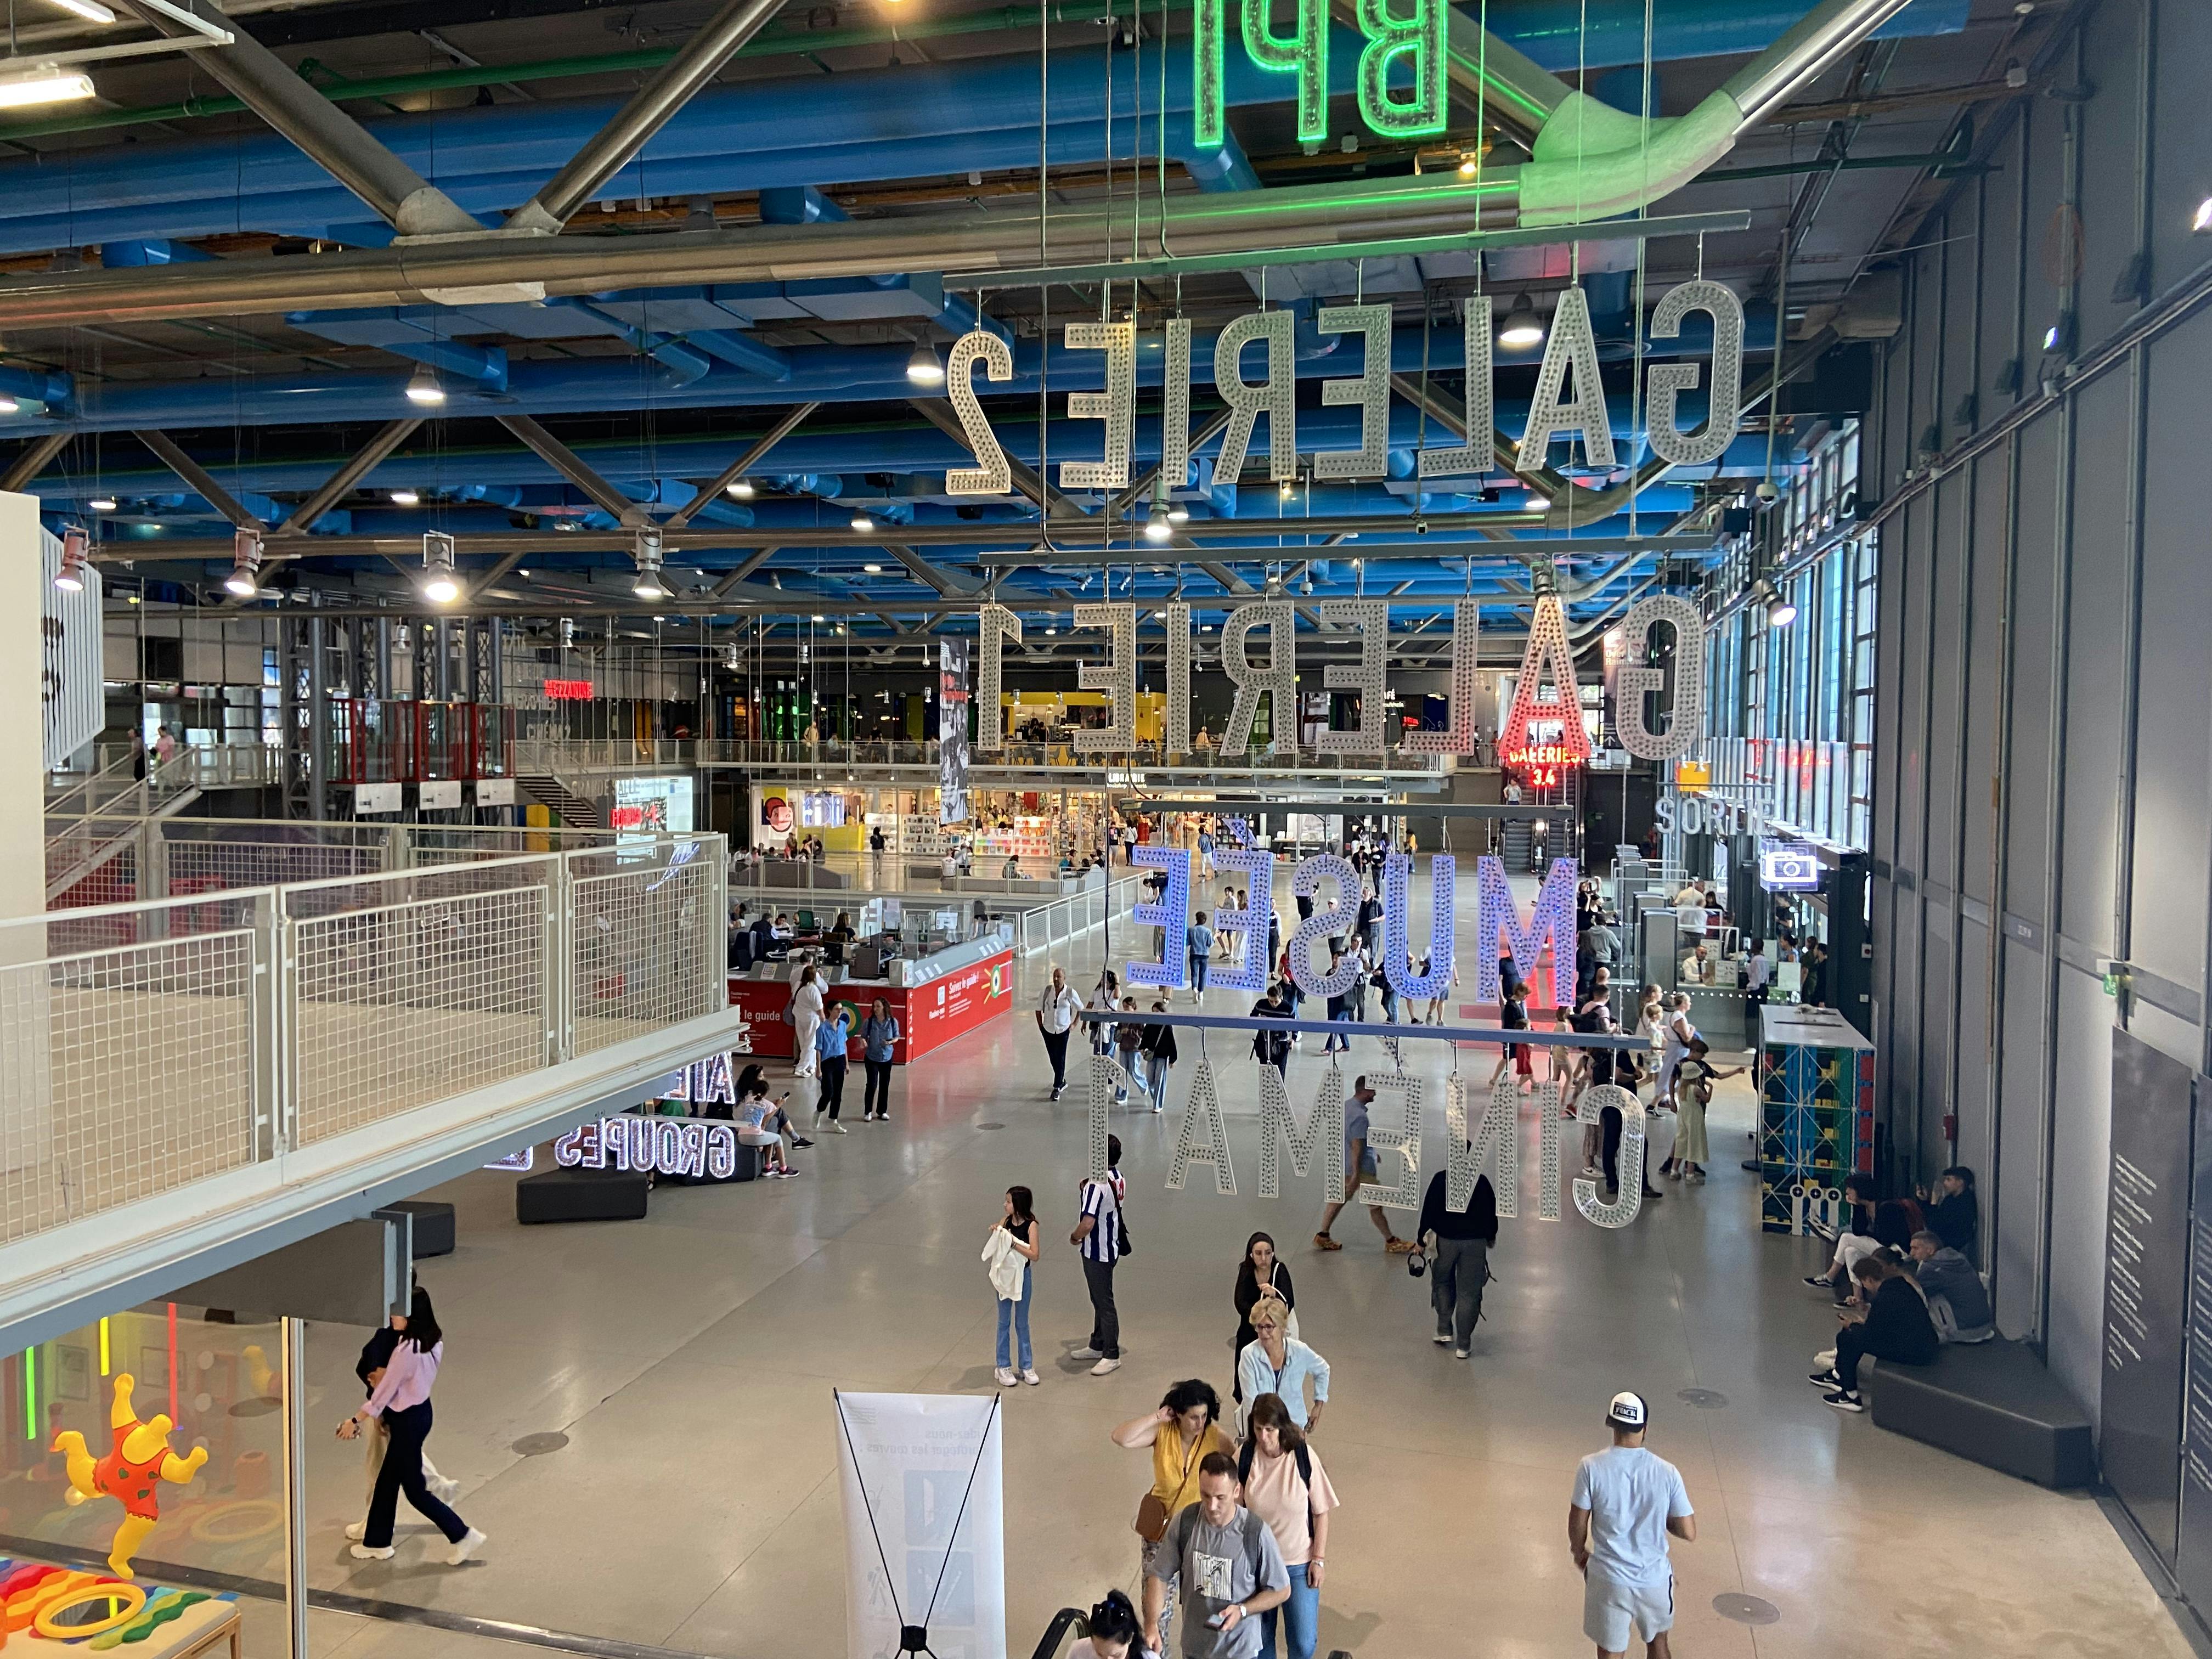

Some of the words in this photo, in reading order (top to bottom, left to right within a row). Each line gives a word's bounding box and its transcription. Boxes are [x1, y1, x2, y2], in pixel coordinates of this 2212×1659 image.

[1654, 797, 1772, 836] SORTIE
[744, 1009, 753, 1020] le
[755, 1010, 780, 1022] guide
